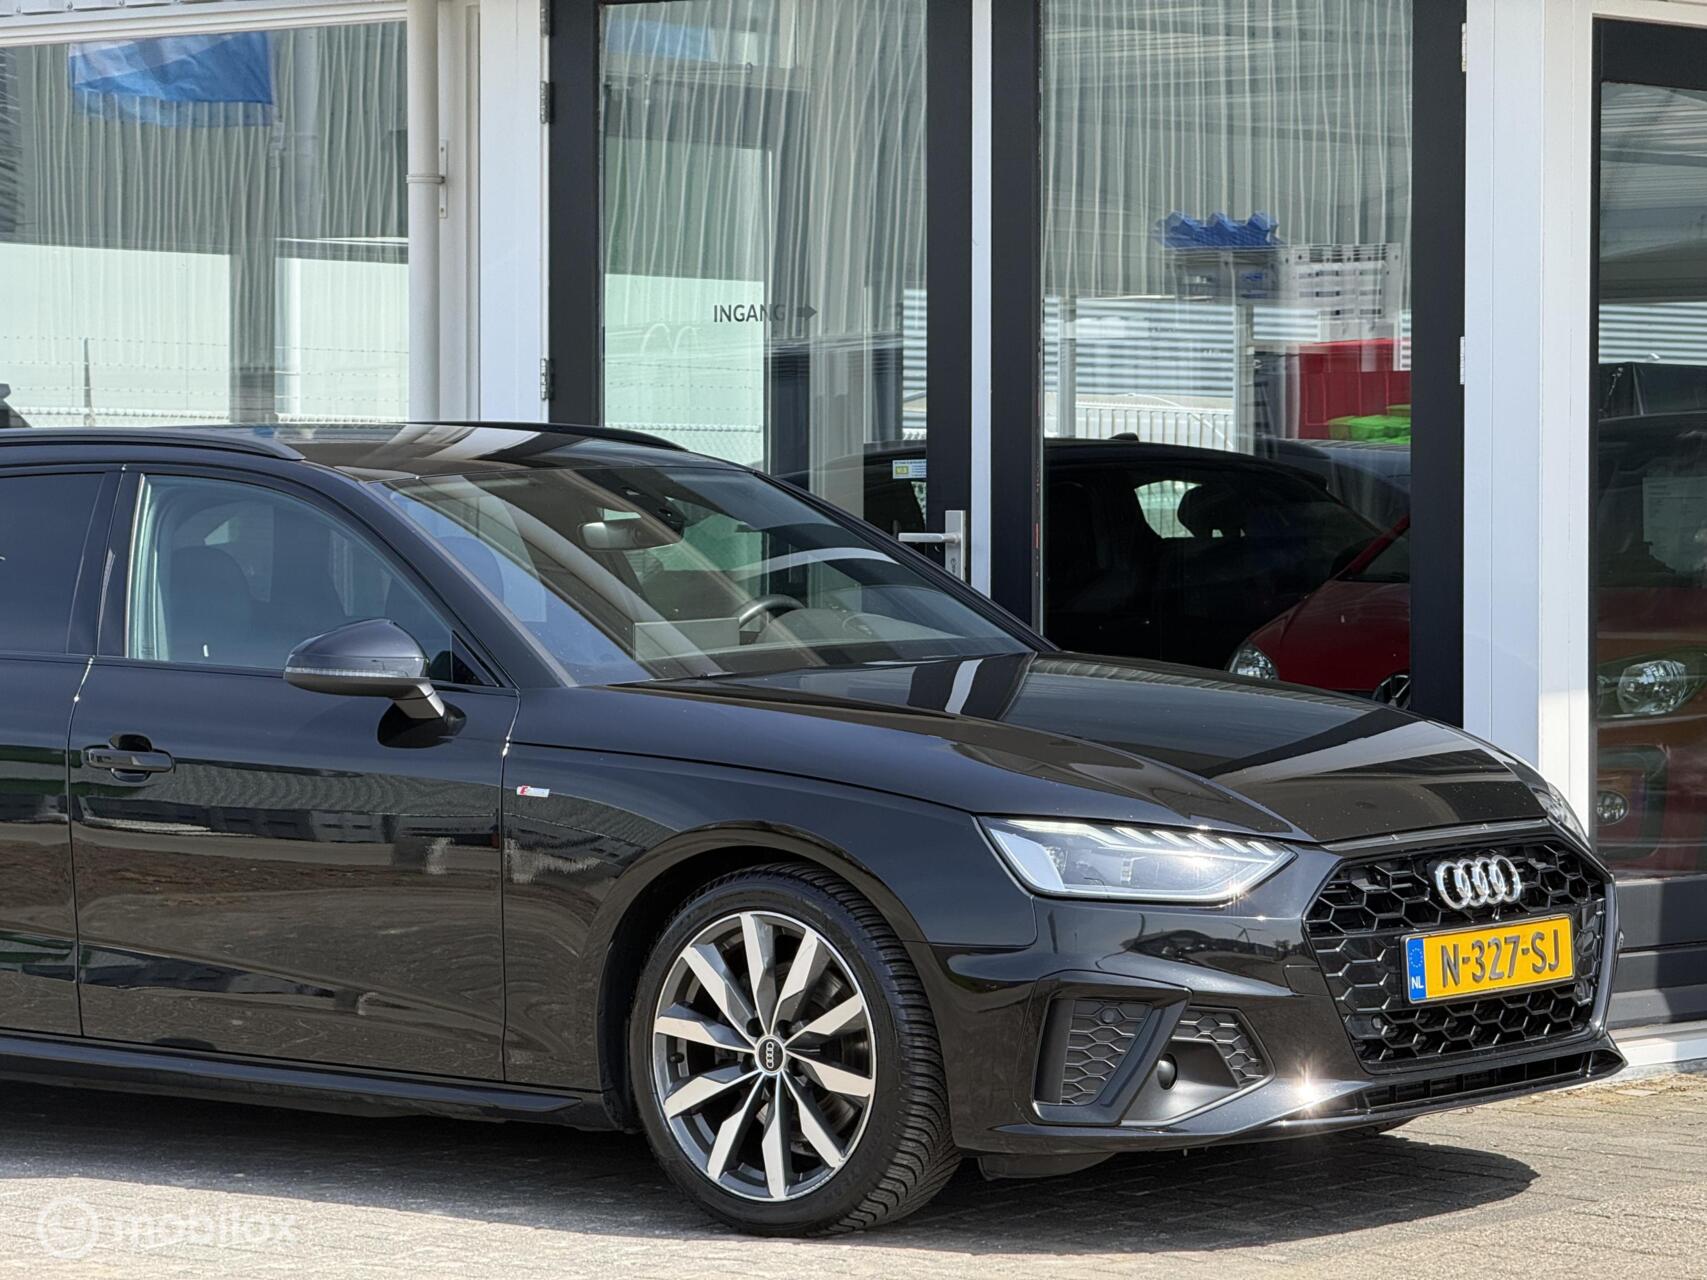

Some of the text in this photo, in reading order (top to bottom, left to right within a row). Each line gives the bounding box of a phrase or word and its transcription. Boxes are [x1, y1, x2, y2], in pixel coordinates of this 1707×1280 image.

[713, 303, 786, 323] INGANG
[1440, 928, 1560, 988] N-327-SJ
[1411, 975, 1425, 990] NL
